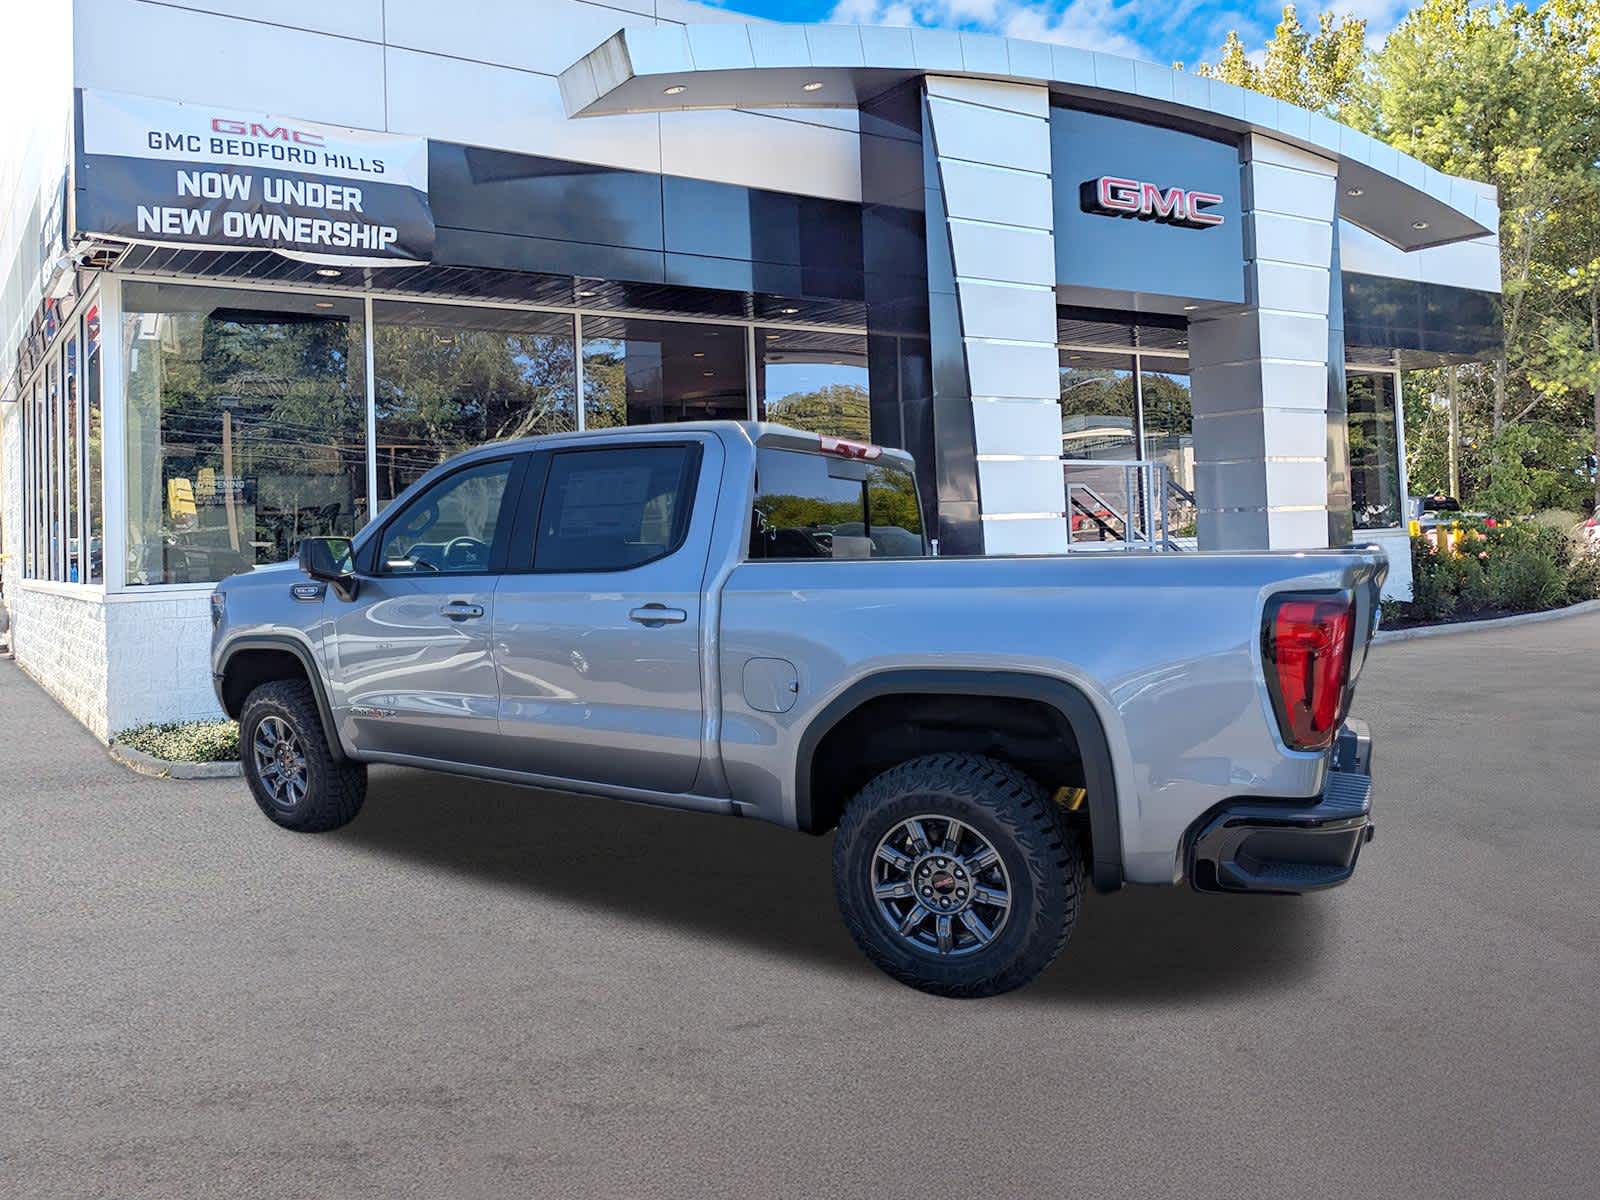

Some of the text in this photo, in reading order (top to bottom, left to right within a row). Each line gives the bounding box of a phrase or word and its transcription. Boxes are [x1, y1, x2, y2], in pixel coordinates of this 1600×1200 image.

[148, 131, 385, 174] GMC BEDFORD HILLS
[211, 118, 325, 147] GMC
[177, 170, 364, 212] NOW UNDER
[1097, 175, 1225, 224] GMC
[137, 205, 398, 250] NEW OWNERSHIP
